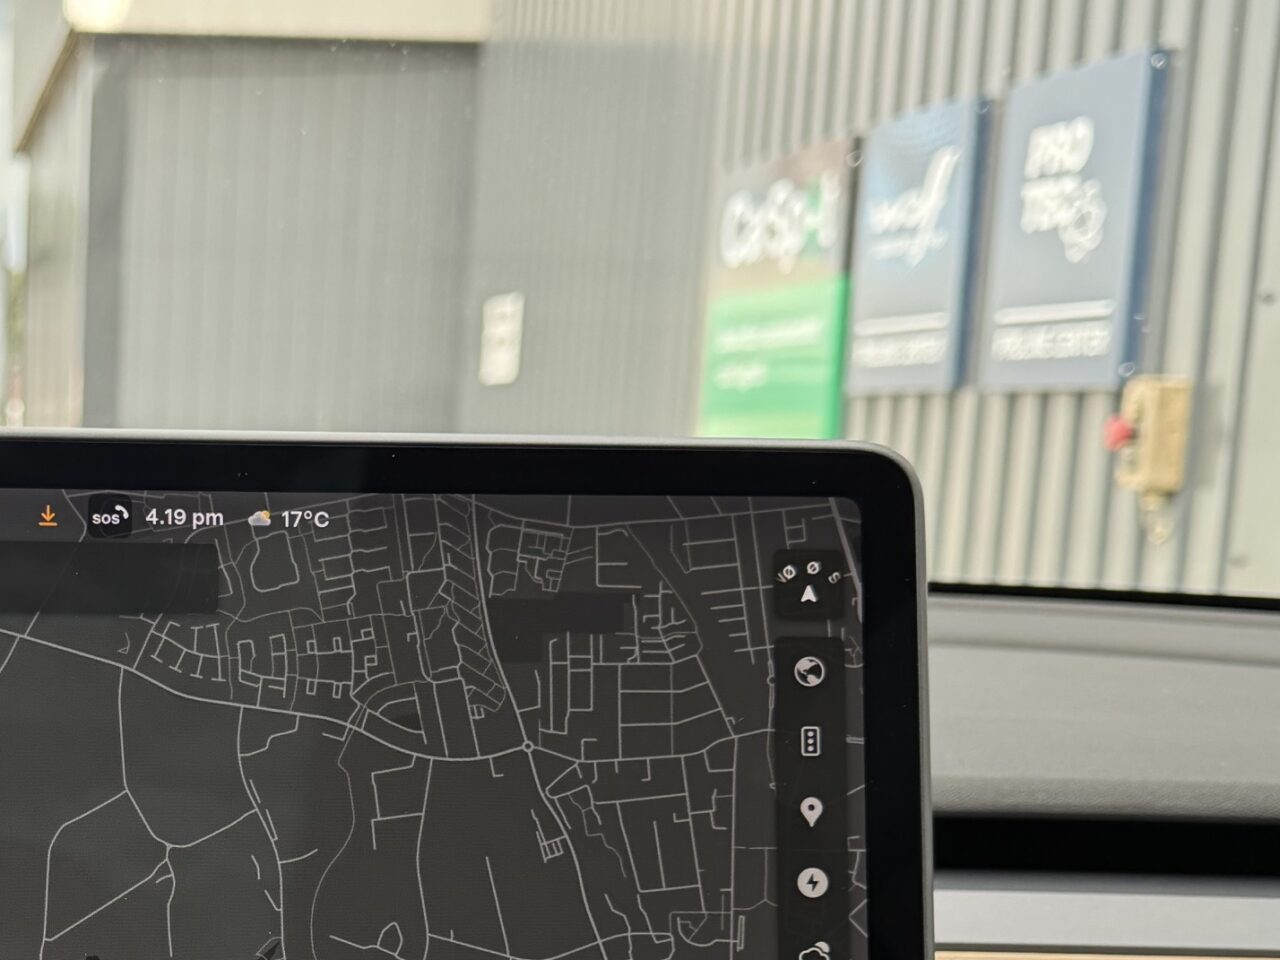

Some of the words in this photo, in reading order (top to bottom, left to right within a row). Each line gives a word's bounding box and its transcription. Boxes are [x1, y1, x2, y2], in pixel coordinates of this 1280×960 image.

[145, 508, 187, 526] 4.19
[191, 512, 225, 530] pm
[281, 509, 330, 529] 17°C
